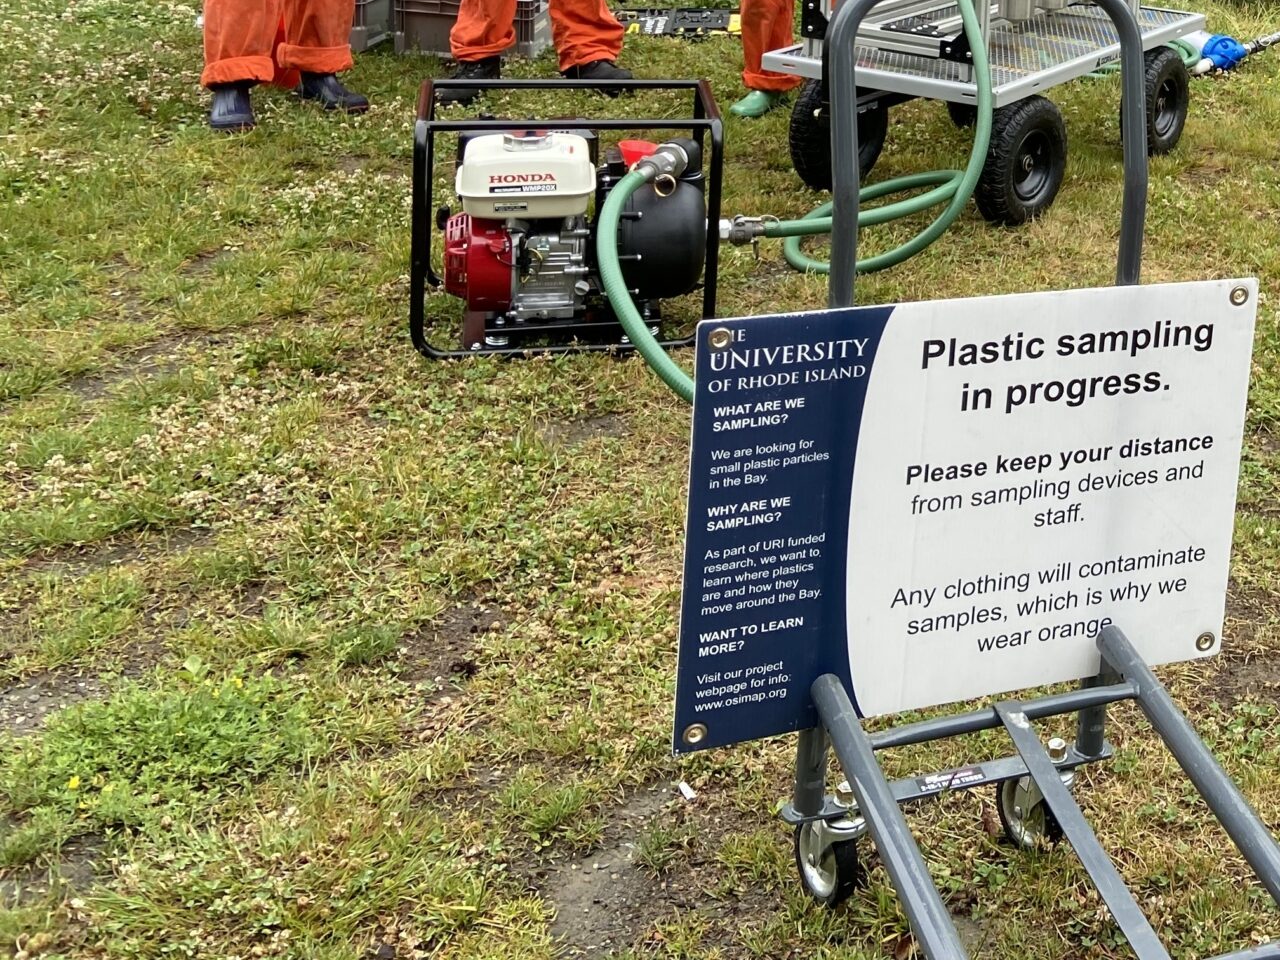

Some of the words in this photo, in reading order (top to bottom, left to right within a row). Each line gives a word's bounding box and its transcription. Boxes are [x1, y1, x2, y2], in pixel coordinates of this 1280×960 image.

[489, 174, 556, 183] HONDA
[710, 338, 869, 371] UNIVERSITY
[921, 332, 1045, 369] Plastic
[1056, 320, 1214, 357] sampling
[708, 378, 732, 393] OF
[737, 371, 799, 390] RHODE
[805, 365, 866, 383] ISLAND
[961, 383, 992, 412] in
[1005, 370, 1170, 414] progress.
[713, 403, 752, 417] WHAT
[754, 400, 781, 413] ARE
[784, 397, 805, 409] WE
[712, 413, 789, 432] SAMPLING?
[711, 450, 731, 460] We
[733, 447, 753, 458] are
[755, 442, 796, 455] looking
[799, 439, 814, 449] for
[906, 459, 988, 485] Please
[996, 453, 1052, 475] keep
[1059, 444, 1113, 470] your
[1119, 434, 1214, 458] distance
[710, 462, 740, 475] small
[743, 457, 780, 472] plastic
[783, 452, 830, 467] particles
[709, 479, 719, 489] in
[723, 476, 741, 487] the
[744, 474, 768, 485] Bay.
[911, 493, 962, 515] from
[970, 477, 1070, 506] sampling
[1078, 469, 1159, 493] devices
[1165, 460, 1204, 482] and
[707, 503, 738, 517] WHY
[740, 500, 767, 512] ARE
[770, 496, 791, 508] WE
[1033, 503, 1085, 528] staff.
[706, 511, 782, 531] SAMPLING?
[704, 549, 720, 560] As
[723, 545, 745, 559] part
[748, 542, 760, 553] of
[763, 538, 784, 551] URI
[787, 532, 826, 547] funded
[703, 558, 756, 574] research,
[760, 555, 777, 565] we
[780, 549, 806, 561] want
[703, 576, 731, 588] learn
[735, 570, 769, 583] where
[772, 562, 814, 578] plastics
[890, 587, 937, 609] Any
[943, 572, 1030, 600] clothing
[1037, 562, 1071, 585] will
[1078, 544, 1206, 578] contaminate
[701, 603, 733, 615] move
[735, 595, 775, 610] around
[778, 592, 796, 603] the
[799, 589, 822, 600] Bay.
[702, 591, 721, 601] are
[724, 586, 745, 598] and
[748, 583, 772, 594] how
[775, 579, 799, 590] they
[906, 605, 1008, 635] samples,
[1016, 591, 1078, 617] which
[1085, 587, 1103, 607] is
[1110, 581, 1152, 603] why
[1158, 577, 1187, 593] we
[699, 628, 737, 643] WANT
[740, 624, 757, 636] TO
[761, 617, 804, 632] LEARN
[977, 628, 1032, 652] wear
[1037, 615, 1113, 642] orange
[698, 640, 745, 657] MORE?
[696, 672, 721, 685] Visit
[723, 669, 743, 680] our
[745, 661, 783, 678] project
[695, 681, 748, 699] webpage
[750, 677, 766, 688] for
[768, 673, 791, 686] info:
[694, 688, 787, 713] www.osimap.org
